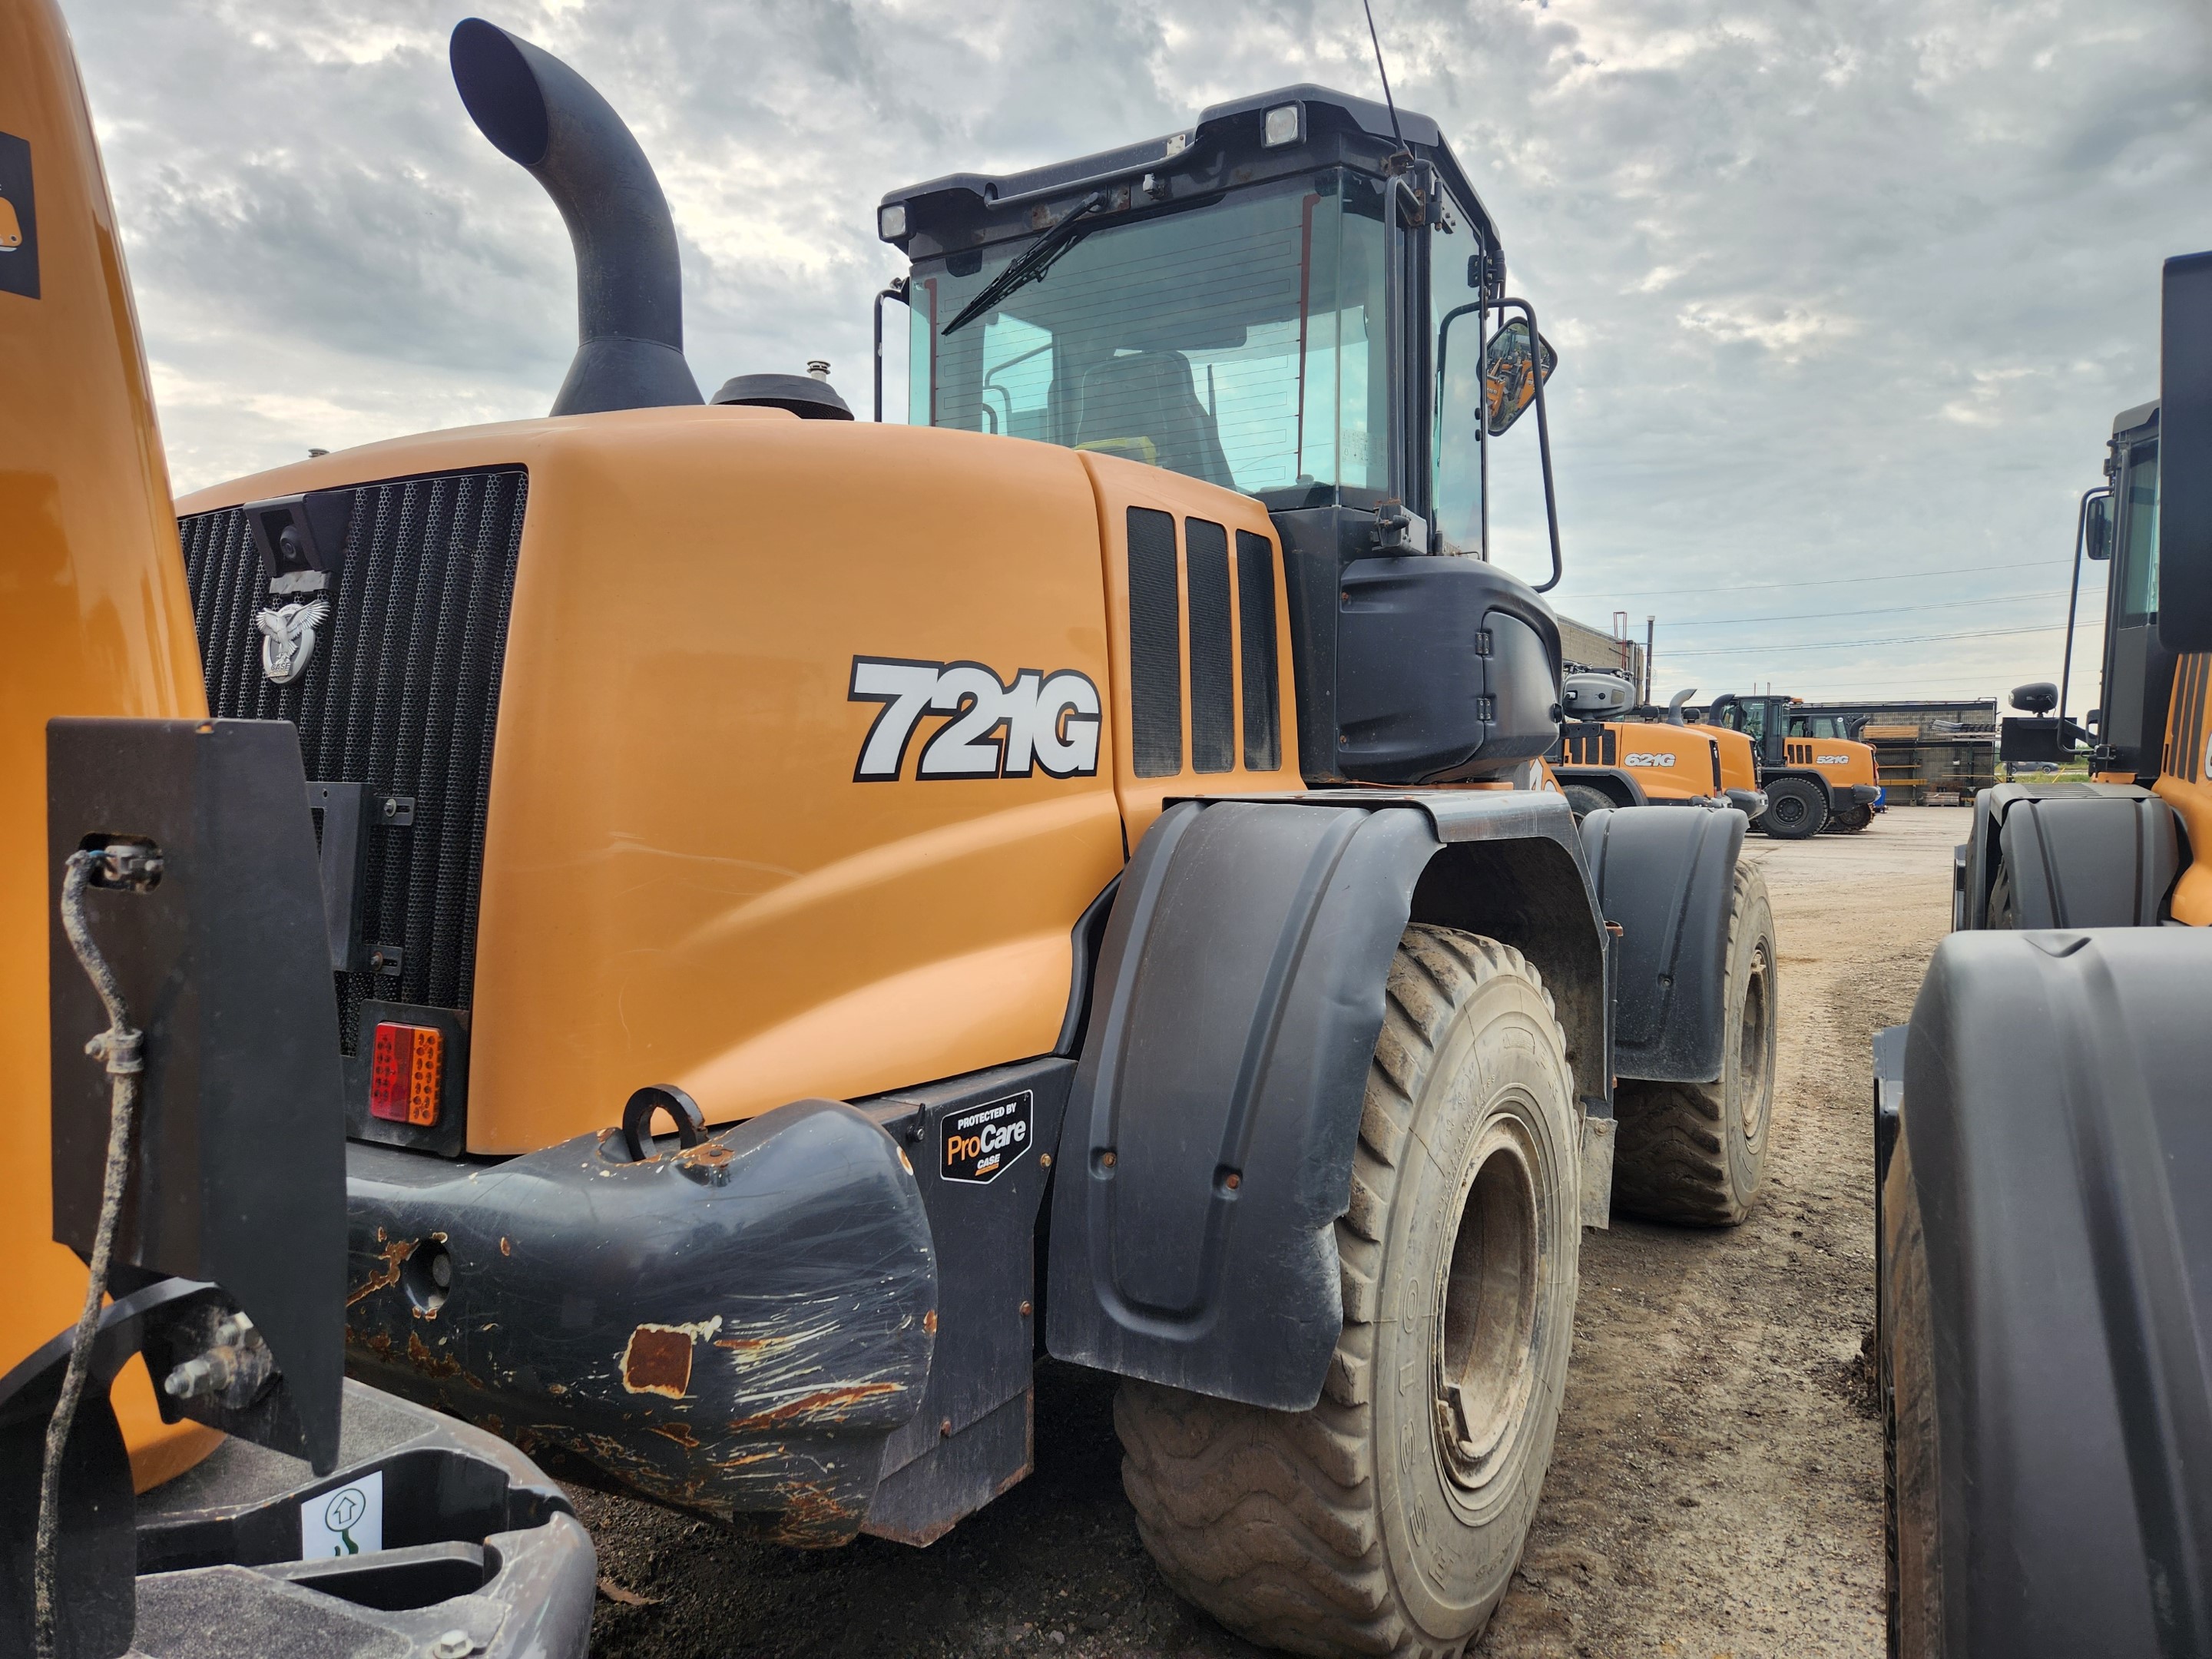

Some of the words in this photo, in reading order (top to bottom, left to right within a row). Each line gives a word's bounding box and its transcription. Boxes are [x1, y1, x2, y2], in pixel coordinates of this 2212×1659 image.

[270, 662, 291, 671] CASE
[847, 654, 1103, 783] 721G
[1624, 753, 1676, 767] 621G
[1816, 755, 1849, 765] 521G
[958, 1107, 1005, 1131] PROTECTED
[1005, 1102, 1017, 1115] BY
[947, 1120, 1027, 1166] ProCare
[977, 1154, 1001, 1169] CASE
